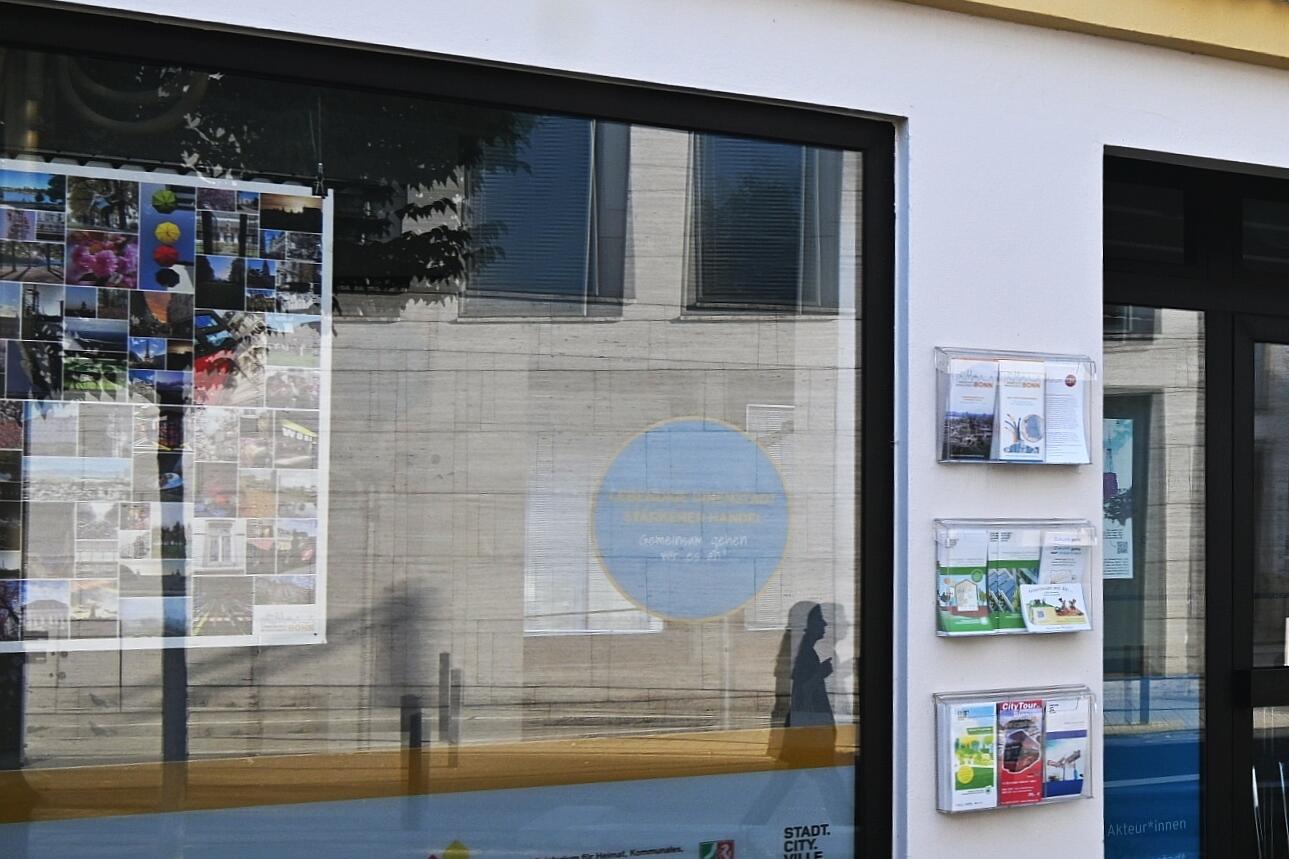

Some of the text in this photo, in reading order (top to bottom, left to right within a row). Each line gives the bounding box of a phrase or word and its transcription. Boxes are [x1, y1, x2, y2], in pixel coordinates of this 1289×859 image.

[639, 534, 748, 550] Gemeinsam gehen
[784, 823, 831, 839] STADT.
[784, 838, 818, 853] CITY.
